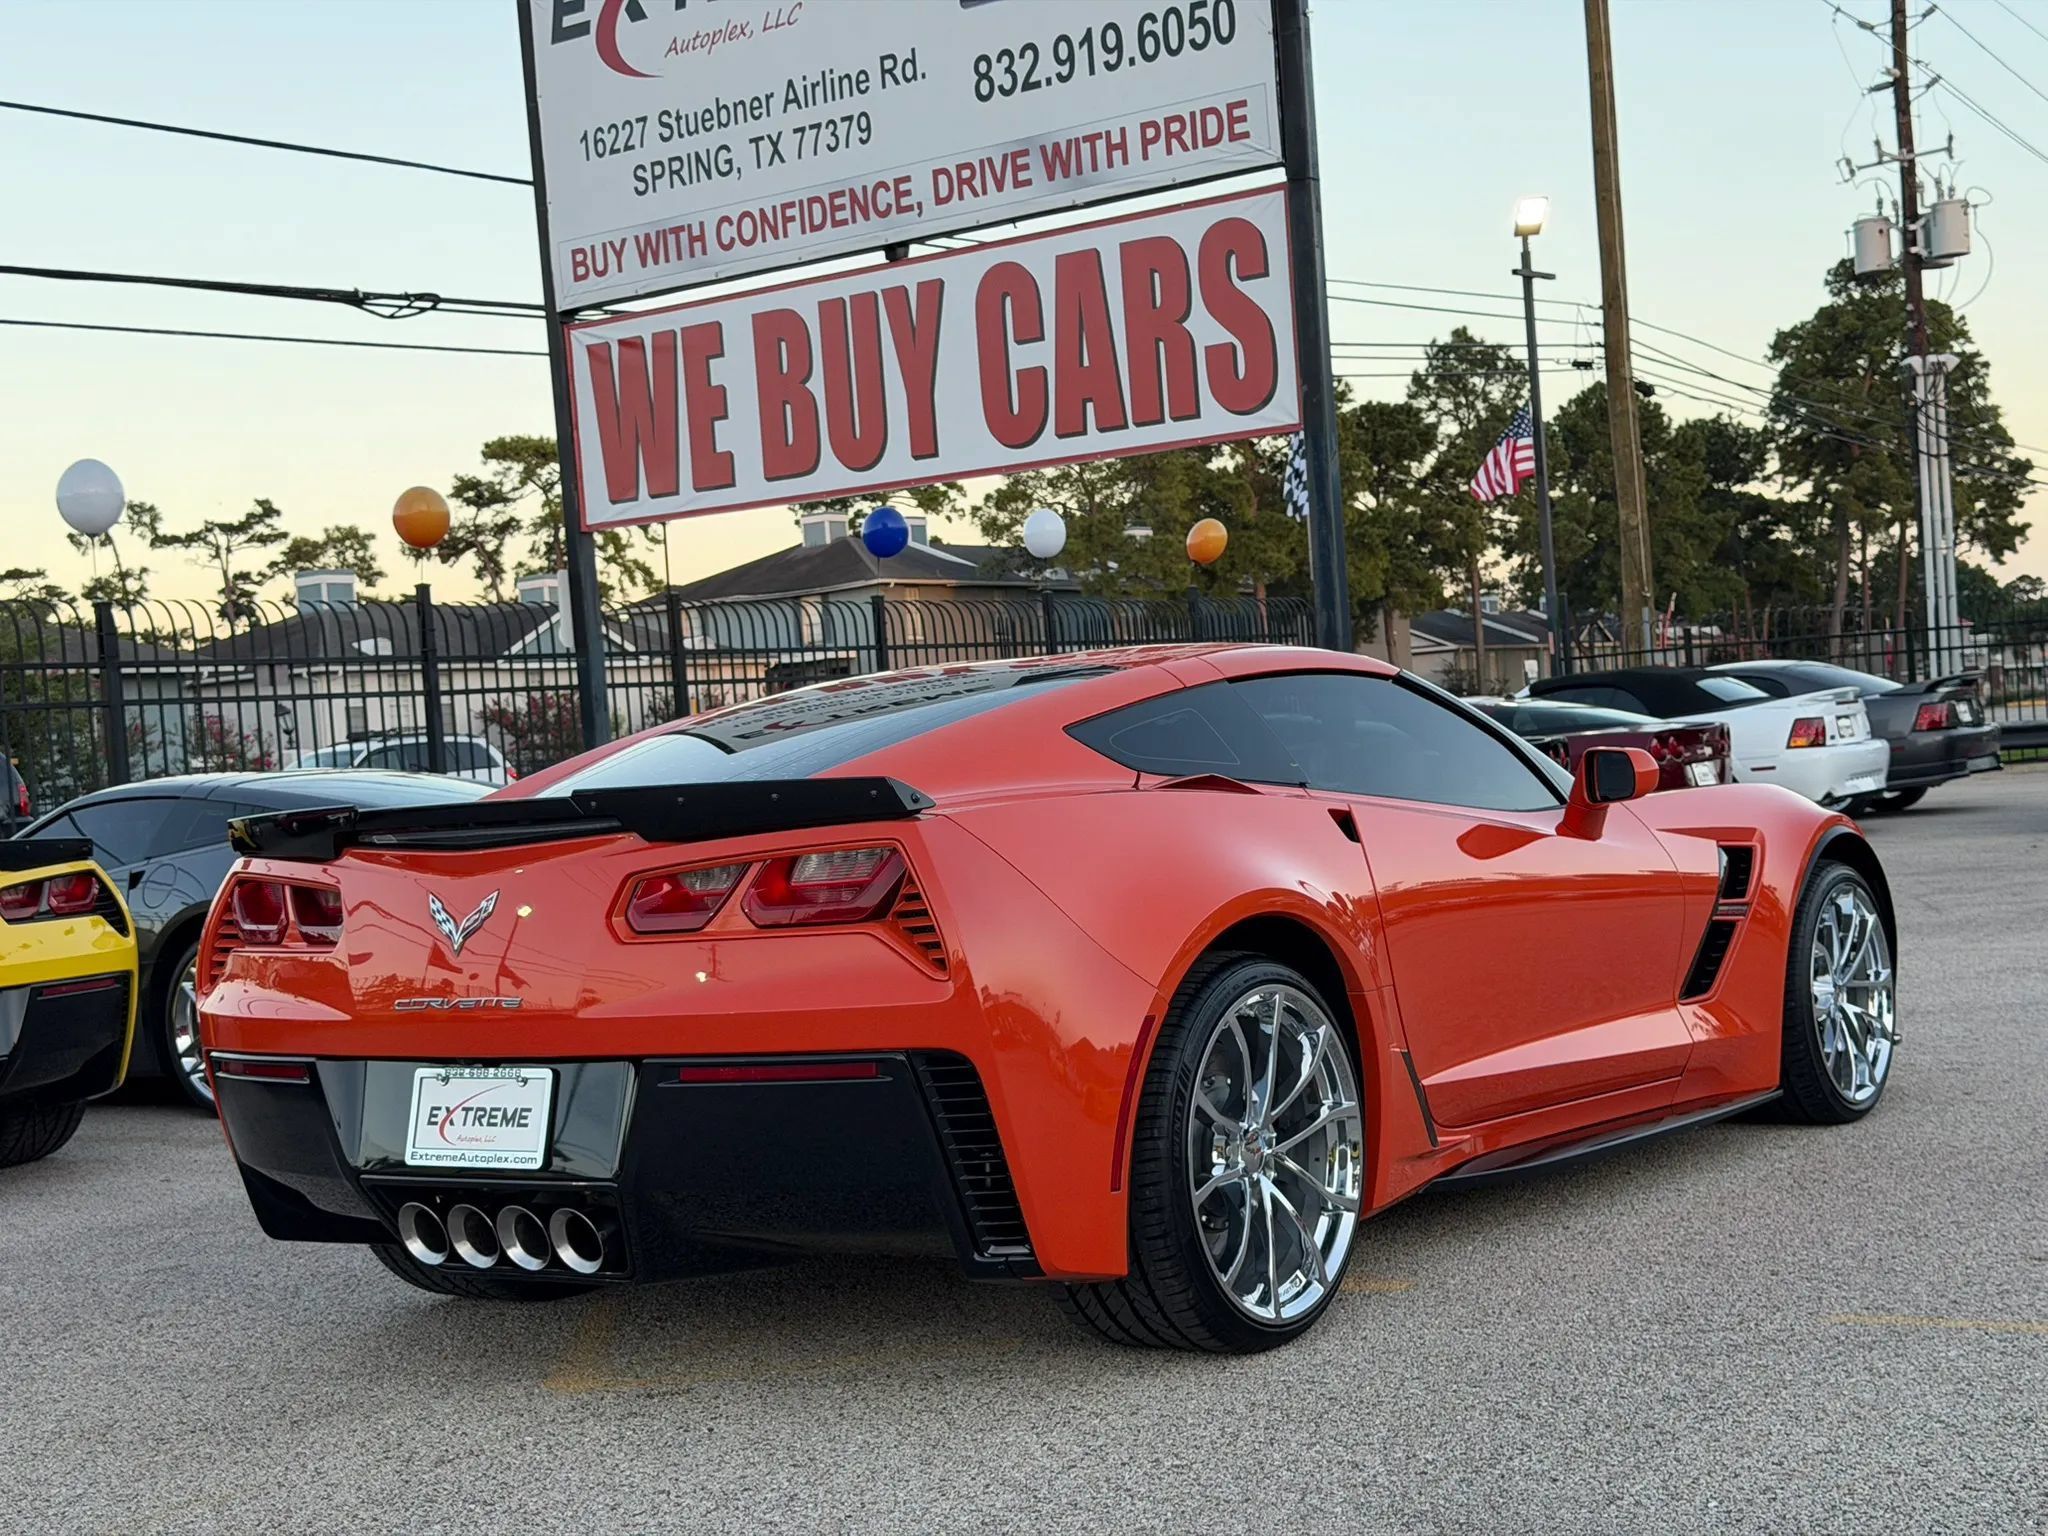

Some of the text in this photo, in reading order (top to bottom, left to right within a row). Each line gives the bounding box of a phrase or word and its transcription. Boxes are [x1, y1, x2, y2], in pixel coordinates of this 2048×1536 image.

[664, 19, 754, 58] Autoplex,
[762, 2, 803, 33] LLC
[973, 0, 1236, 102] 832.919.6050
[579, 48, 927, 161] 16227 Stuebner Airline Rd.
[571, 99, 1251, 282] BUY WITH CONFIDENCE, DRIVE WITH PRIDE
[633, 111, 873, 197] SPRING, TX 77379
[586, 217, 1278, 505] WE BUY CARS
[394, 996, 523, 1011] CORVETTE
[410, 1151, 538, 1166] ExtremeAutoplex.com
[427, 1105, 532, 1128] EXTREME
